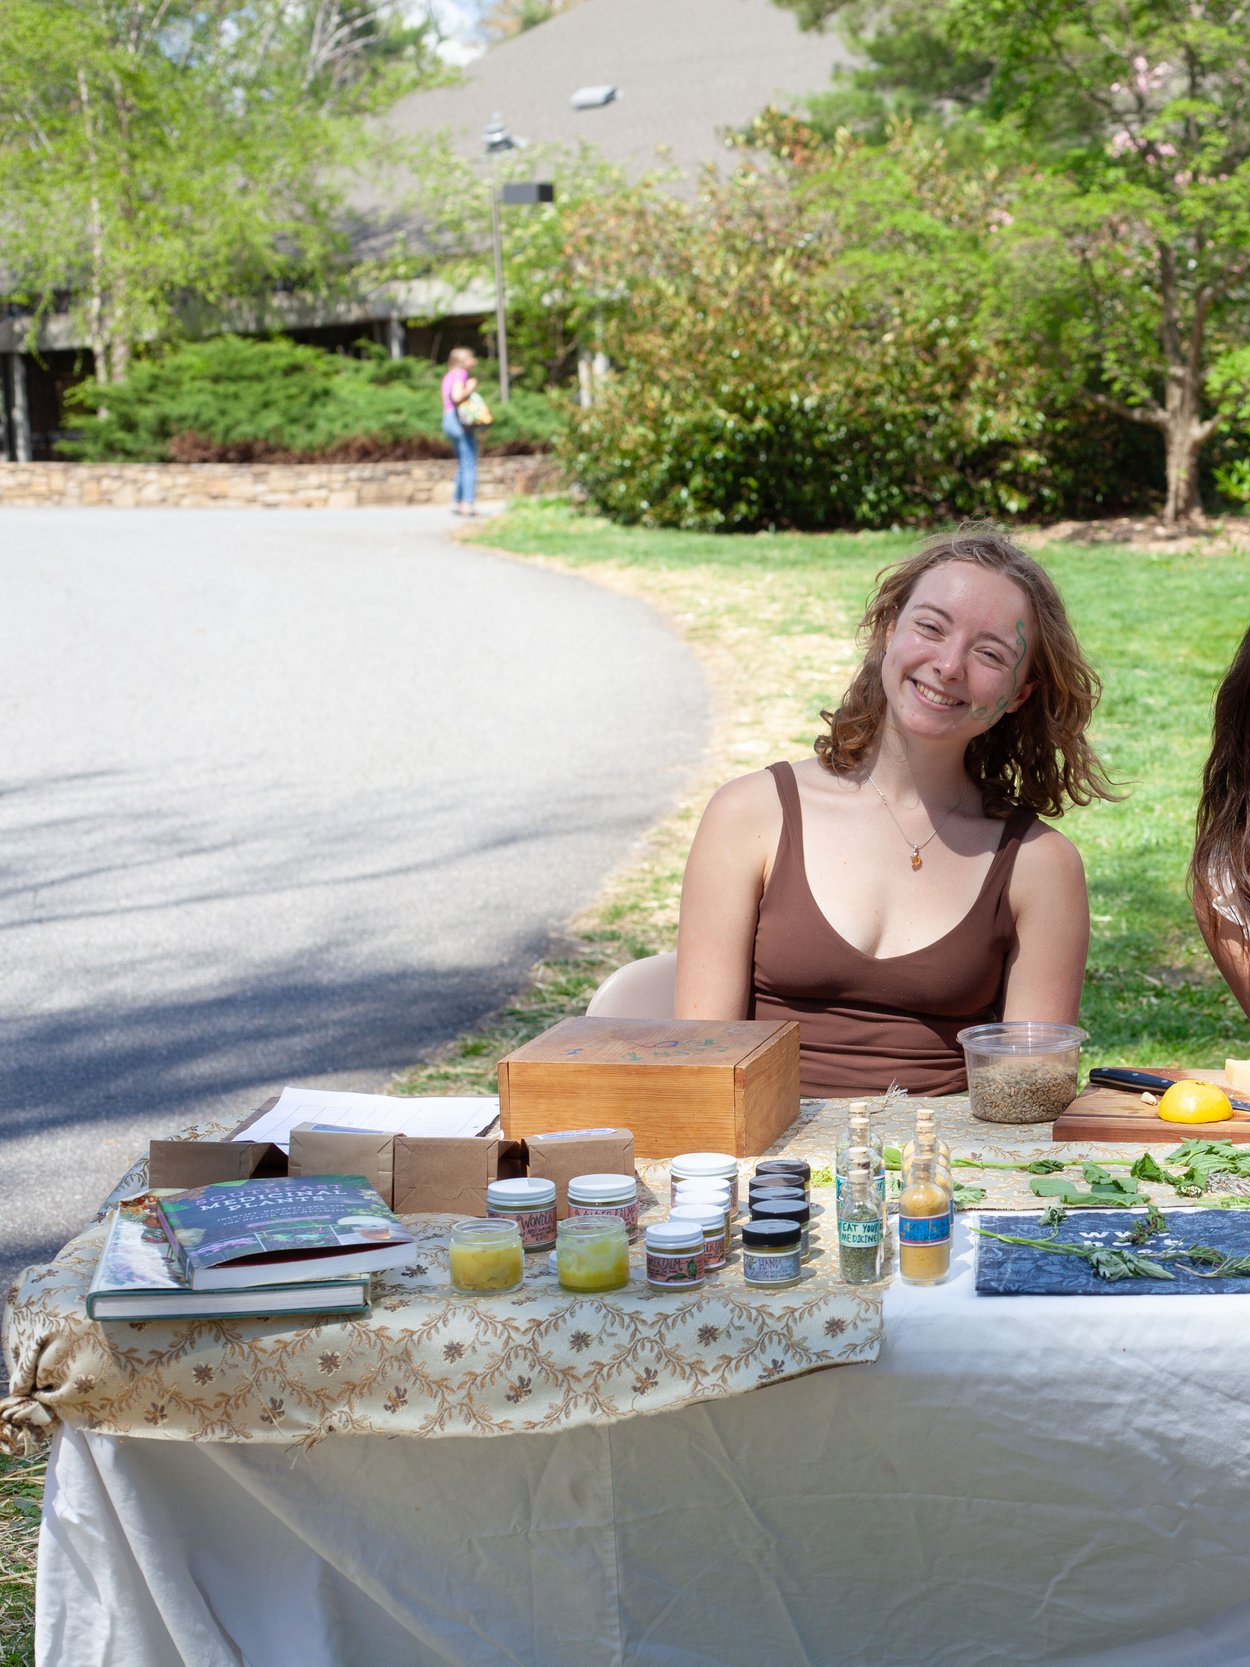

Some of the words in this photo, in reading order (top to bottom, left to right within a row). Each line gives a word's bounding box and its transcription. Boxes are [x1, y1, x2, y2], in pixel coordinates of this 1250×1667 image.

[195, 1184, 343, 1206] SOUTHEAST
[200, 1189, 347, 1212] MEDICINAL
[229, 1196, 325, 1212] PLANTS
[842, 1222, 858, 1232] EAT
[840, 1233, 878, 1243] MEDICINE
